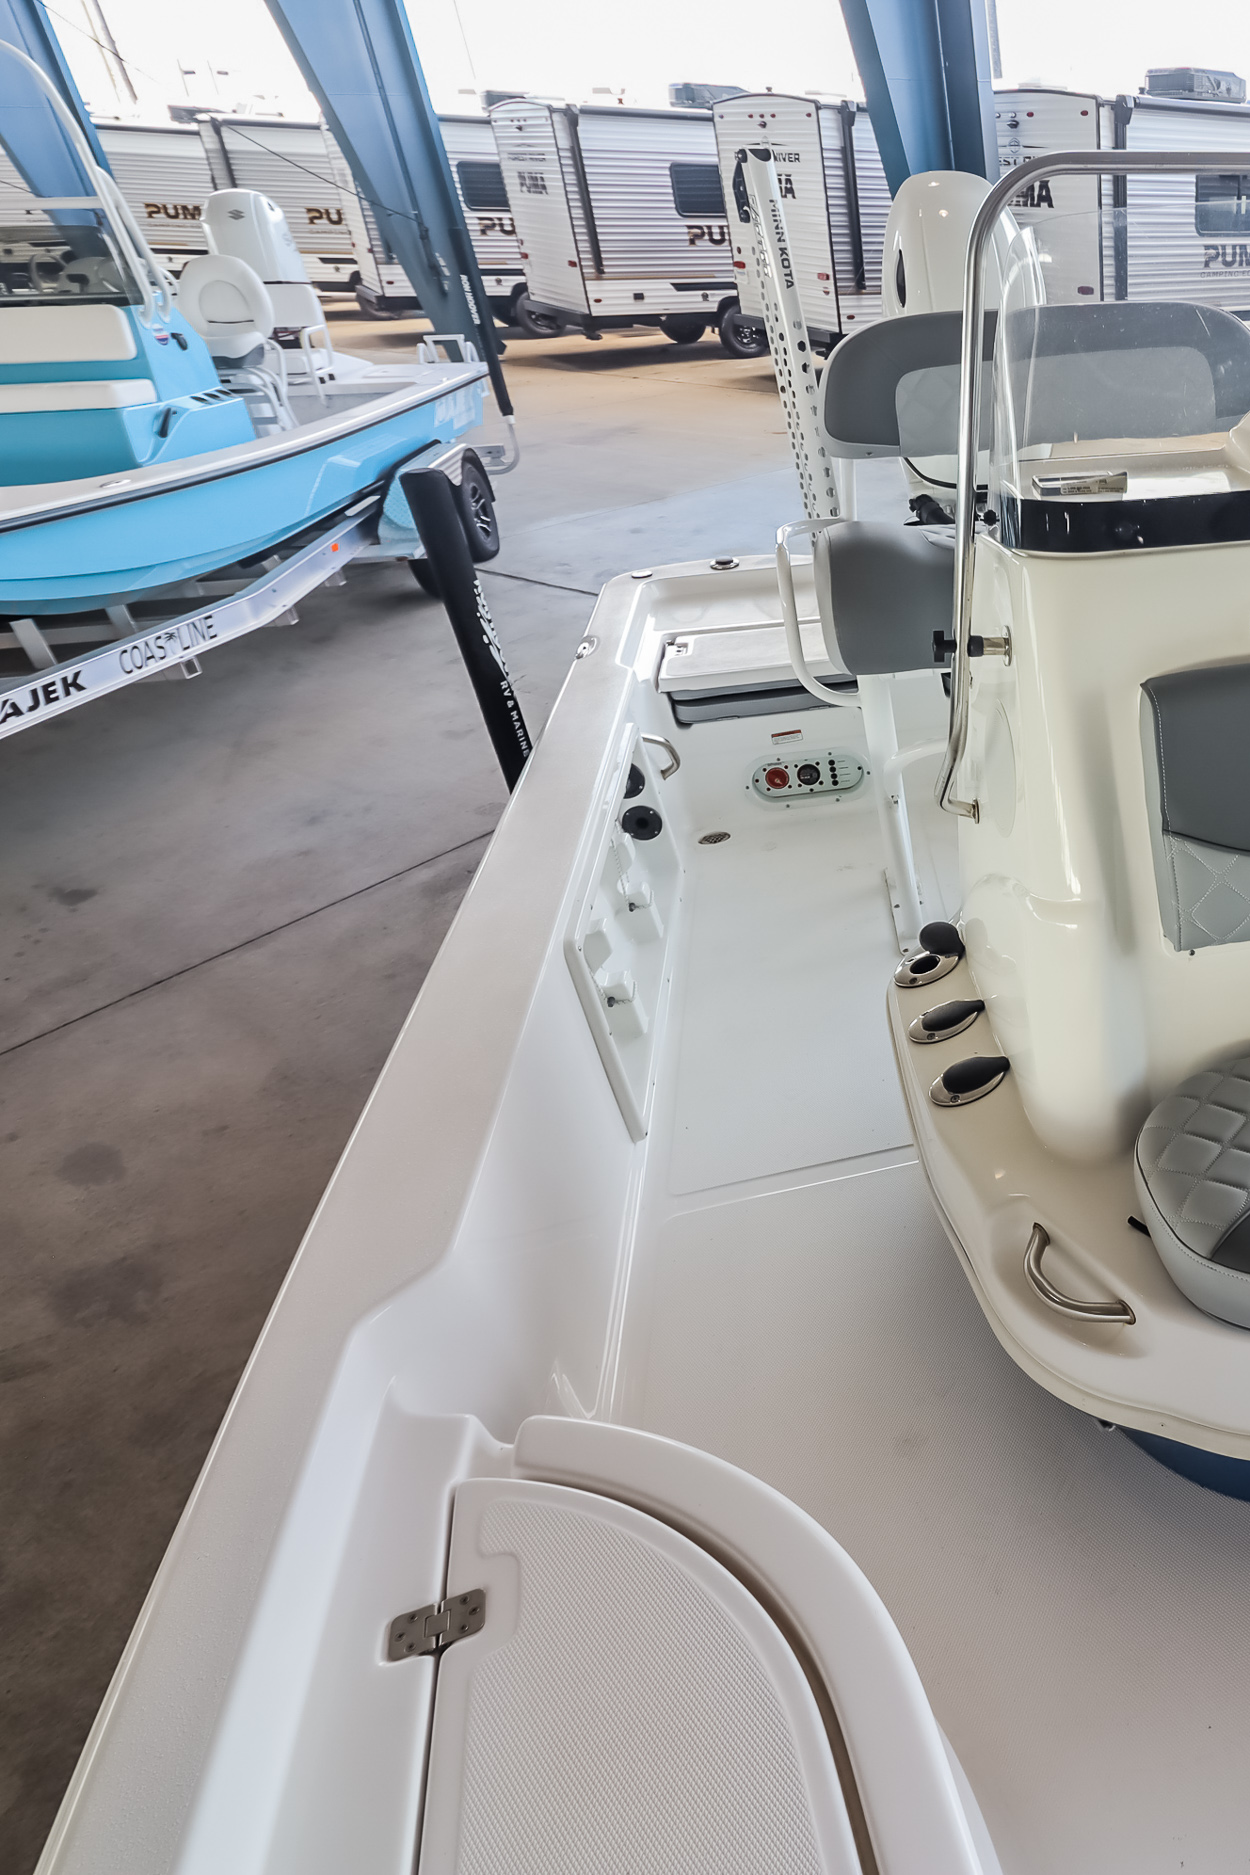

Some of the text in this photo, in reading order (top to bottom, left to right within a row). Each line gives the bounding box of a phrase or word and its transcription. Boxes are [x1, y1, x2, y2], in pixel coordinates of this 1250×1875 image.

[143, 202, 202, 220] PUM
[305, 207, 343, 226] PU
[477, 217, 517, 236] PU
[686, 225, 728, 246] PU
[769, 199, 794, 289] MINN KOTA
[1200, 270, 1239, 278] CAMPING
[500, 680, 512, 697] RV
[510, 711, 529, 758] MARINE
